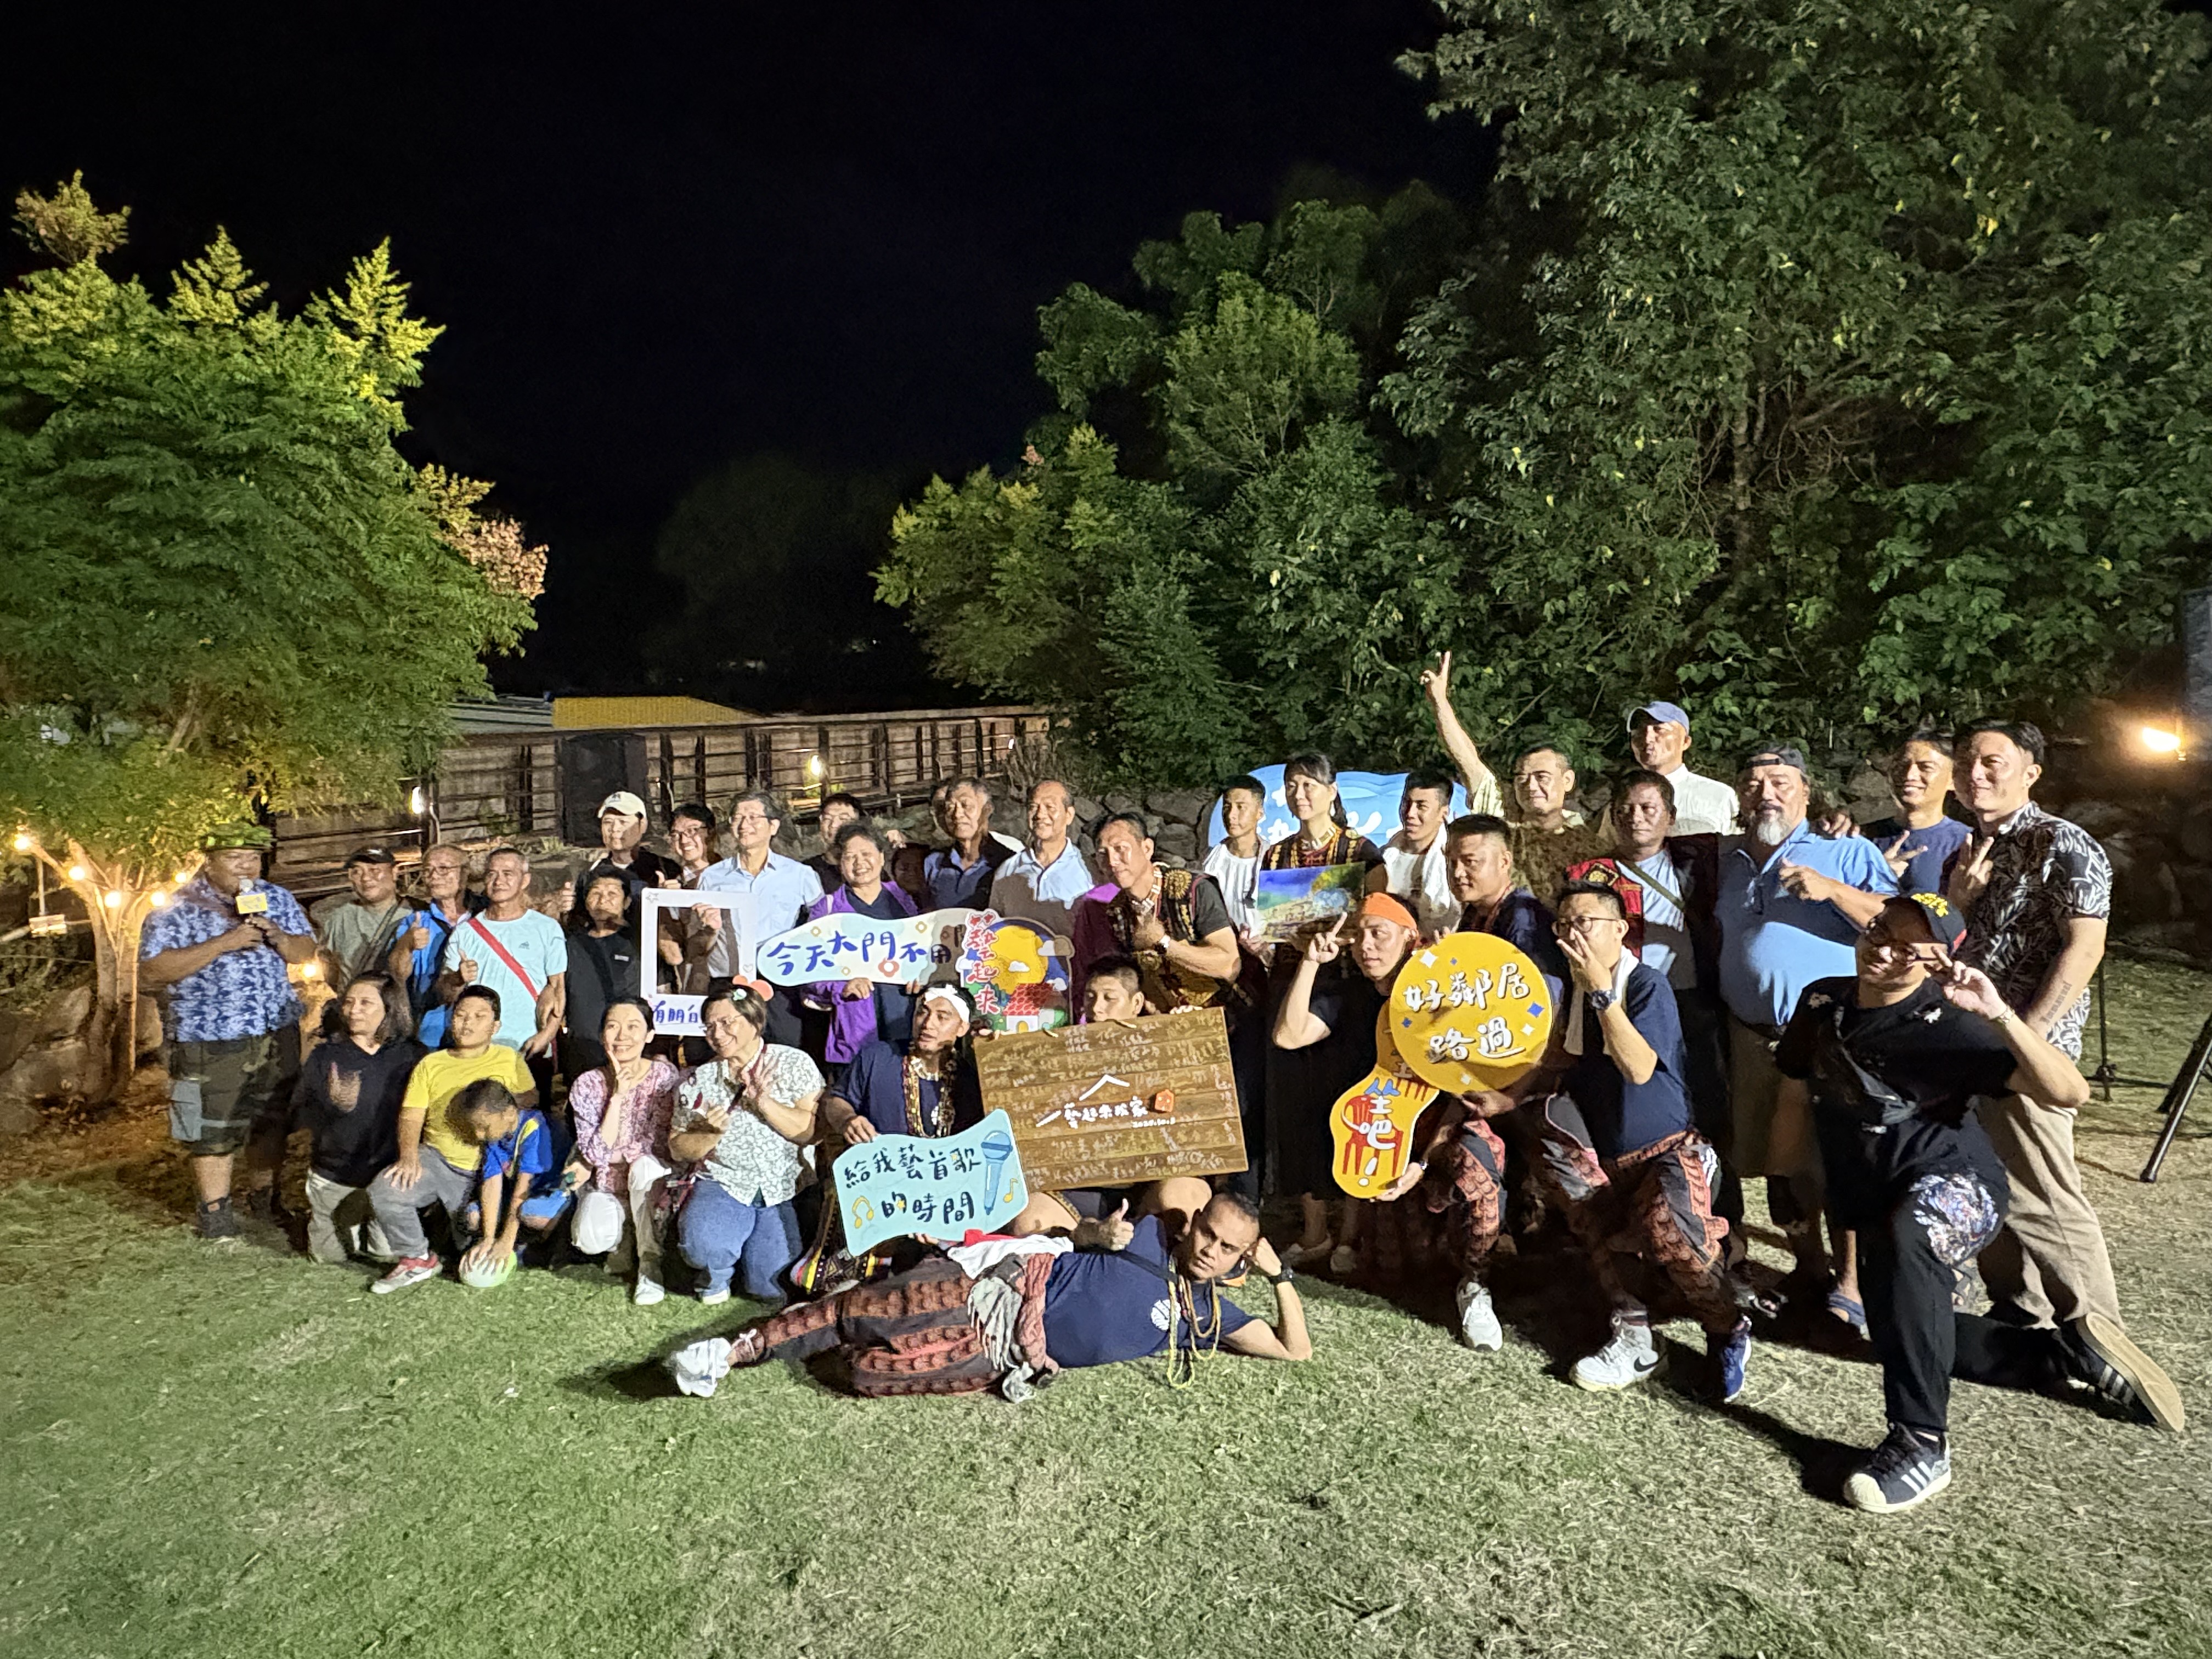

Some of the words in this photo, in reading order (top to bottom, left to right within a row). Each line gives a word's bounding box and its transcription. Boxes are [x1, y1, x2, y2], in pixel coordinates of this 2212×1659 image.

[966, 912, 1000, 1014] 藝起來
[1402, 962, 1531, 1012] 好鄰居
[1425, 1015, 1526, 1063] 路過
[844, 1143, 981, 1188] 給我藝首歌
[881, 1191, 975, 1224] 的時間
